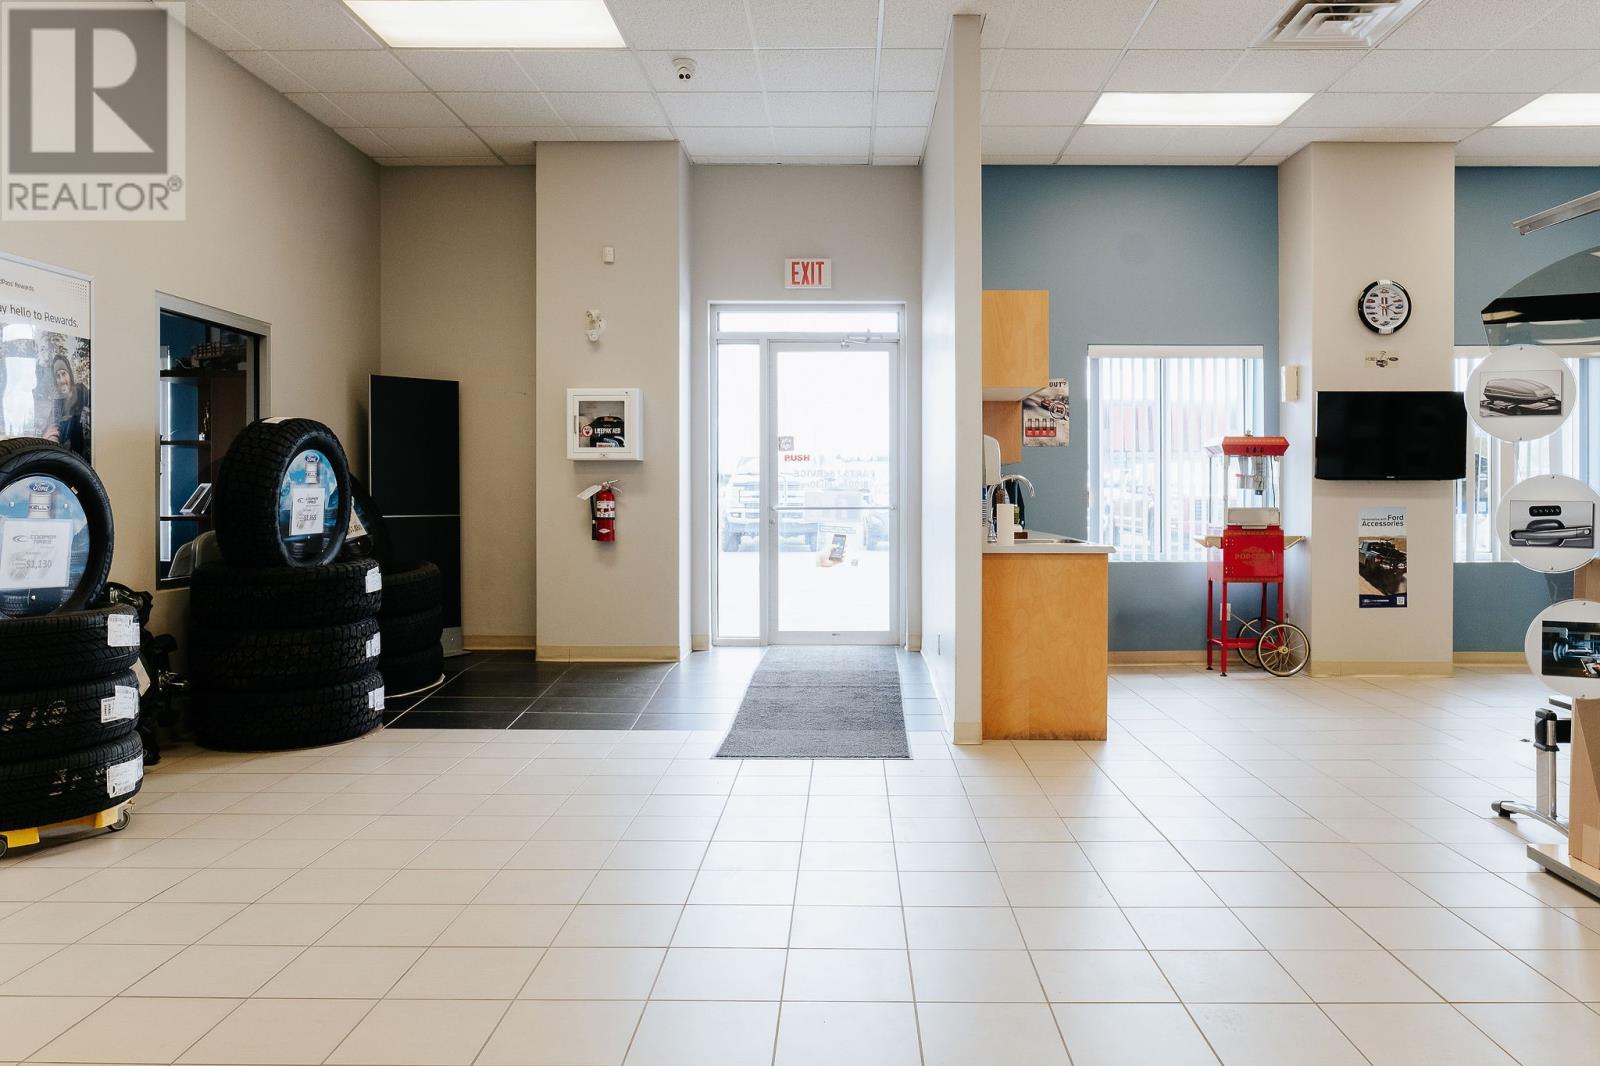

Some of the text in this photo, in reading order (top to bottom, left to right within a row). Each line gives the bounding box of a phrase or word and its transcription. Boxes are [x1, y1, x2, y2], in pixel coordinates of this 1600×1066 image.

[791, 261, 825, 285] EXIT
[10, 304, 31, 318] hello
[33, 310, 42, 320] to
[44, 311, 79, 328] Rewards.
[784, 454, 810, 462] PUSH
[32, 484, 50, 492] Ford
[26, 559, 53, 569] $1,130
